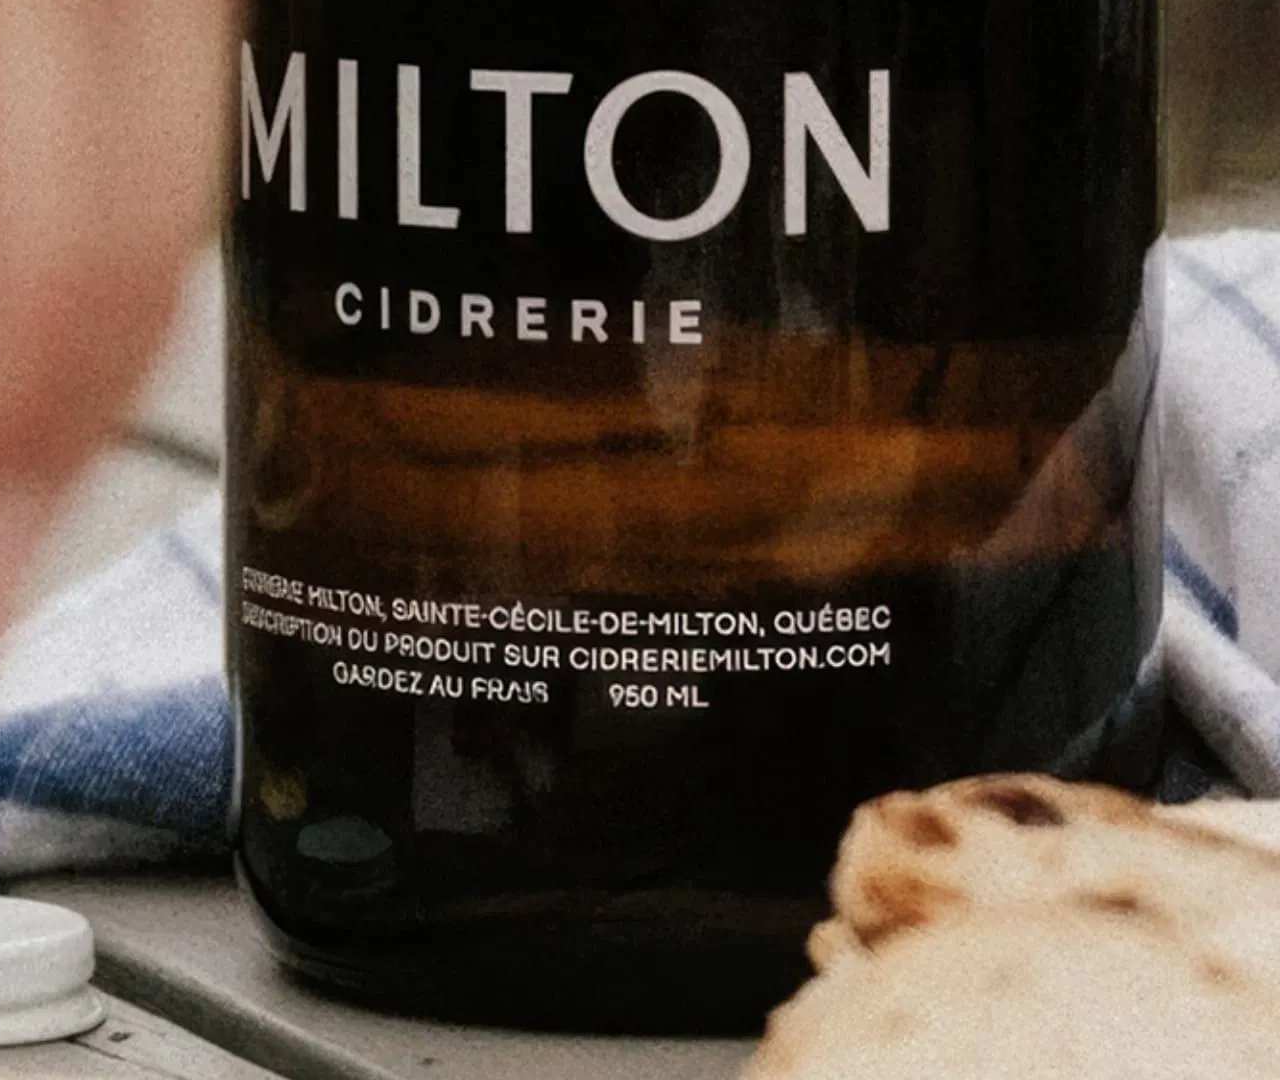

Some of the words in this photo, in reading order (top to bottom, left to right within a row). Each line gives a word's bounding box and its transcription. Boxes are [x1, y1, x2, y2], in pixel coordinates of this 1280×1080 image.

[240, 39, 891, 242] MILTON
[334, 280, 703, 345] CIDRERIE
[391, 597, 766, 638] SAINTE-CÉCILE-DE-MILTON,
[773, 602, 893, 636] QUÉBEC
[347, 626, 379, 653] DU
[383, 632, 497, 665] PRODUIT
[503, 642, 561, 670] SUR
[569, 641, 892, 672] CIDRERIEMILTON.COM
[332, 660, 425, 696] GARDEZ
[428, 674, 464, 699] AU
[471, 675, 550, 704] FRAIS
[608, 683, 659, 709] 950
[665, 684, 710, 708] ML
